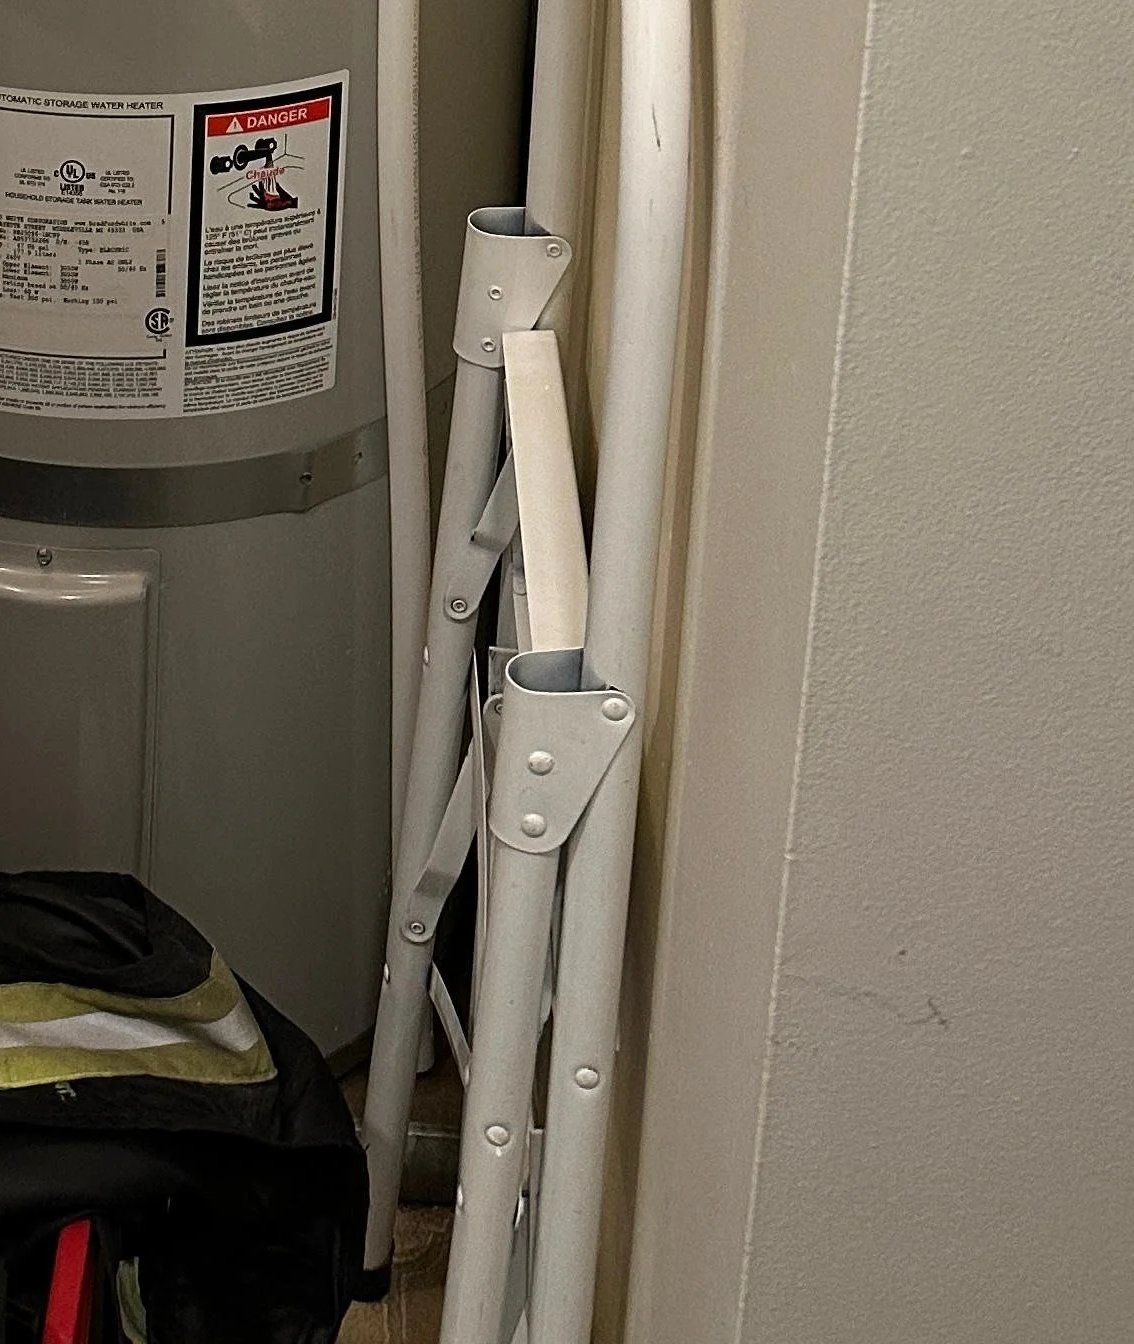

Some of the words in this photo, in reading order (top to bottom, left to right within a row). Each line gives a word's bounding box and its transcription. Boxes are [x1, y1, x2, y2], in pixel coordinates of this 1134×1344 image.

[43, 97, 88, 109] STORAGE
[90, 101, 125, 110] WATER
[126, 101, 164, 110] HEATER
[246, 108, 307, 129] DANGER
